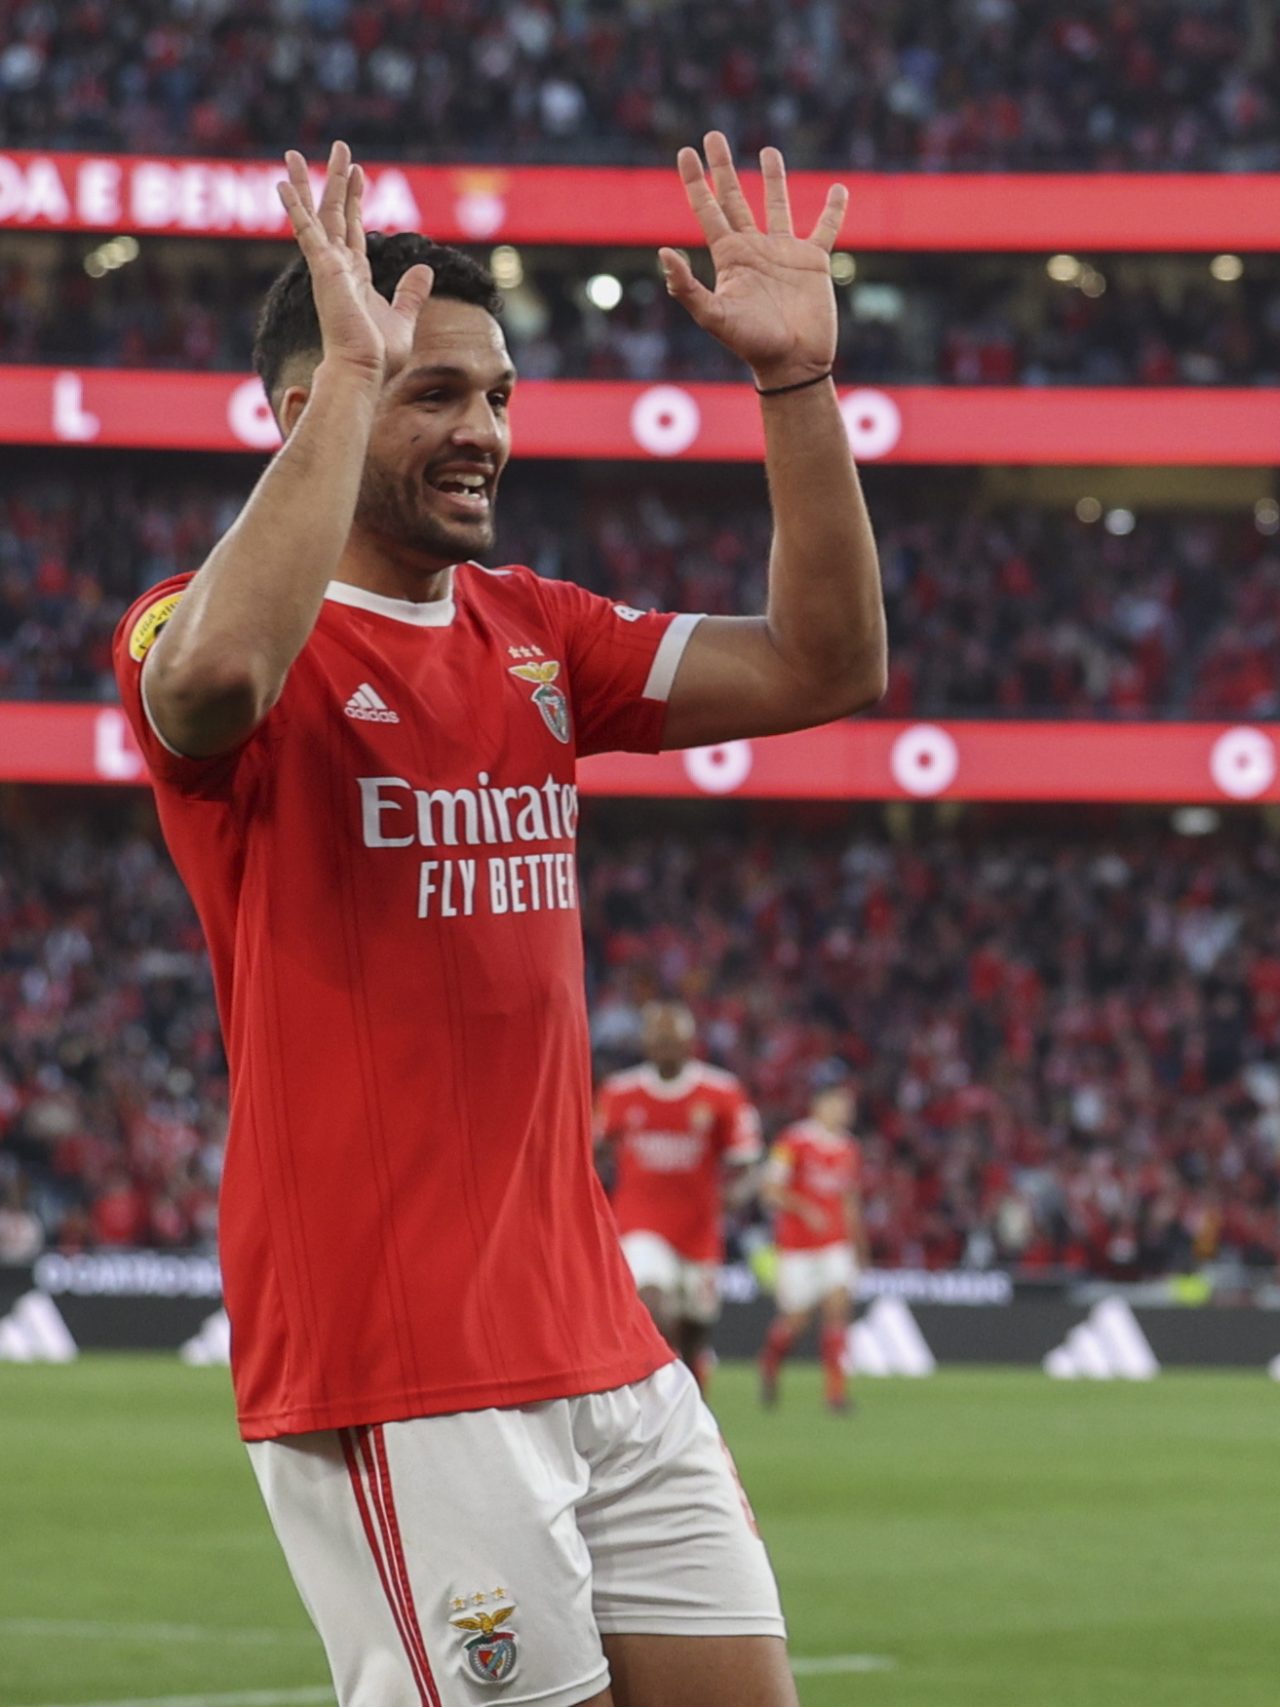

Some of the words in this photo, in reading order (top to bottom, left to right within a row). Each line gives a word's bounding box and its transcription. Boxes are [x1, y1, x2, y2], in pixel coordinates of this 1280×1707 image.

[76, 159, 120, 225] E
[52, 373, 99, 441] L
[630, 385, 700, 455] O
[343, 707, 400, 724] adidas
[891, 725, 958, 795] O
[356, 771, 579, 848] Emirate
[418, 859, 476, 918] FLY
